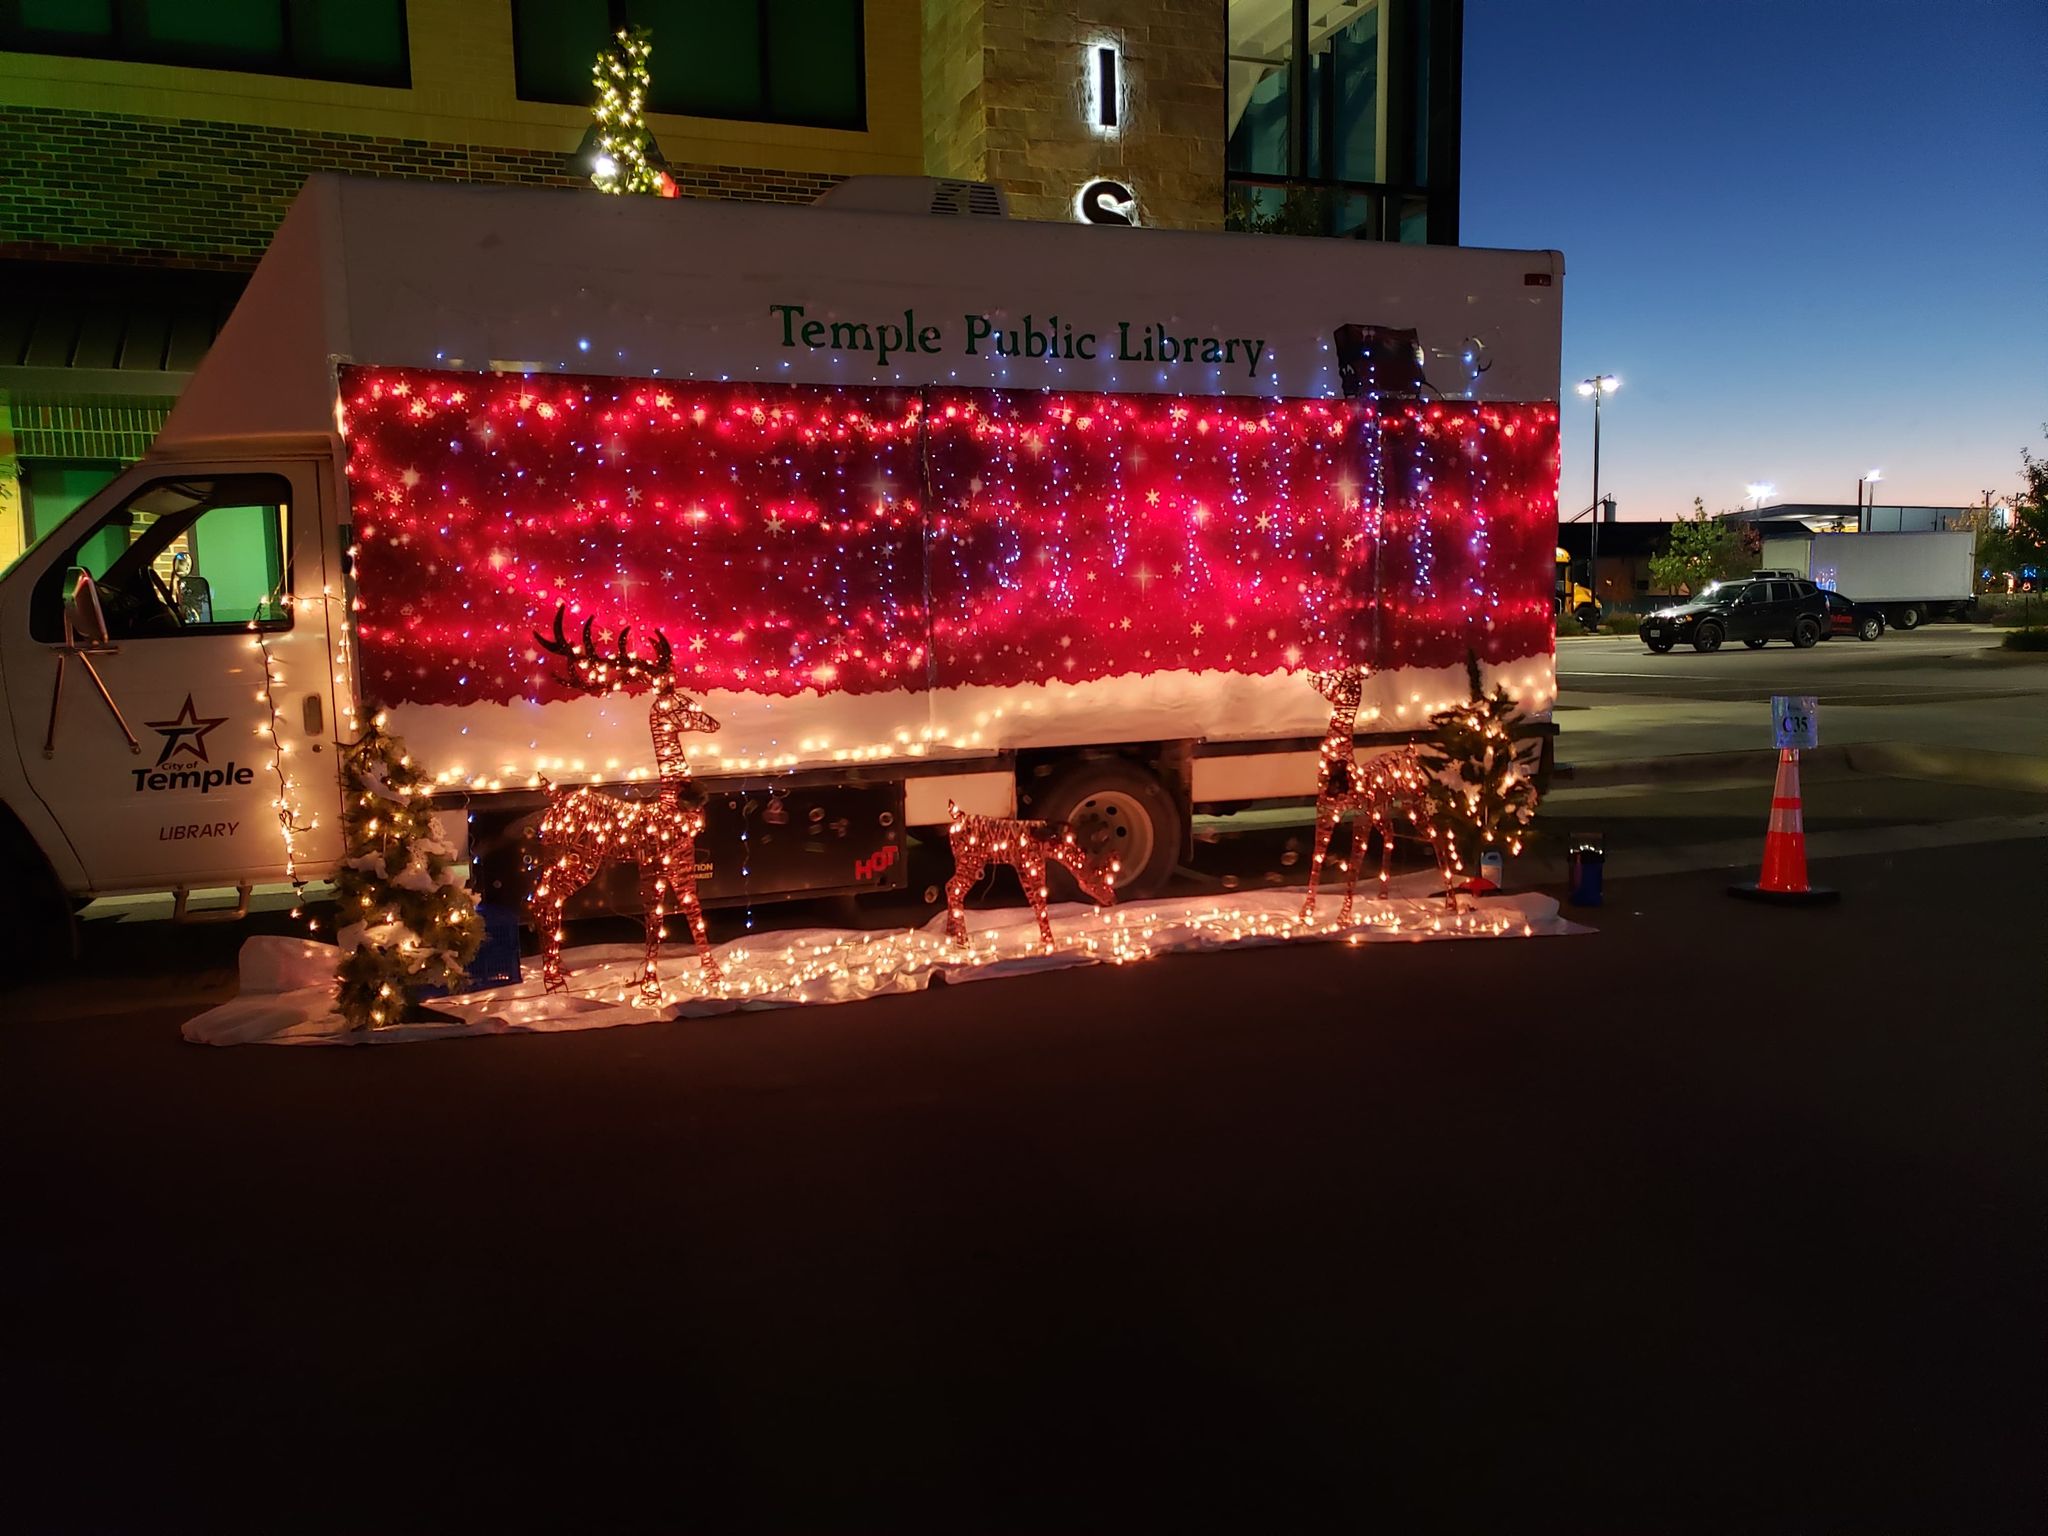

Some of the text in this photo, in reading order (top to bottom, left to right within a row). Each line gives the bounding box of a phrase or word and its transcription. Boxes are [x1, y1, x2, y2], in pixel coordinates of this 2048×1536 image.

[769, 304, 1266, 377] Temple Public Library
[131, 762, 254, 794] Temple
[162, 761, 198, 771] City of
[159, 821, 240, 841] LIBRARY
[855, 845, 898, 880] HOT
